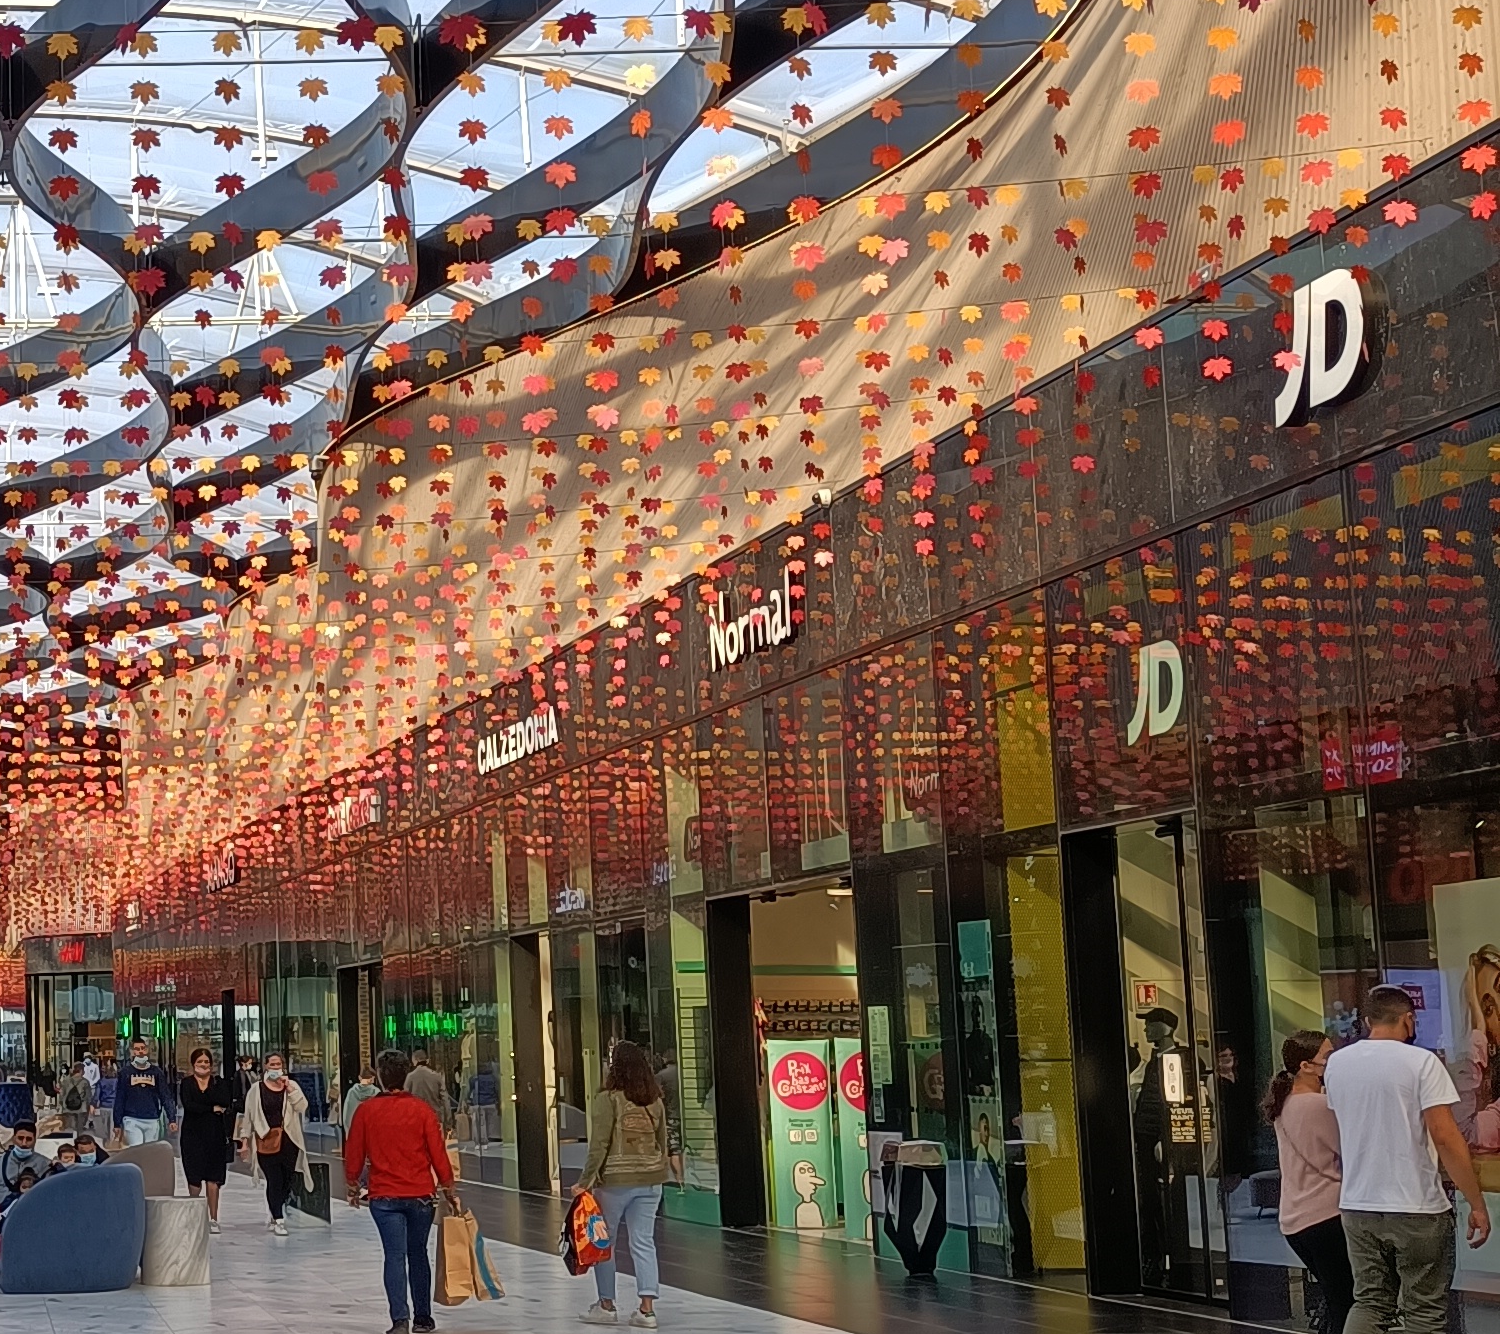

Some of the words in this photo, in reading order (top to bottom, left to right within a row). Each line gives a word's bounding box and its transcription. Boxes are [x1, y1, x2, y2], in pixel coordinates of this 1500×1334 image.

[1274, 268, 1365, 428] JD
[708, 564, 792, 673] Normal
[477, 705, 559, 776] CALZEDONIA
[1127, 638, 1184, 747] JD
